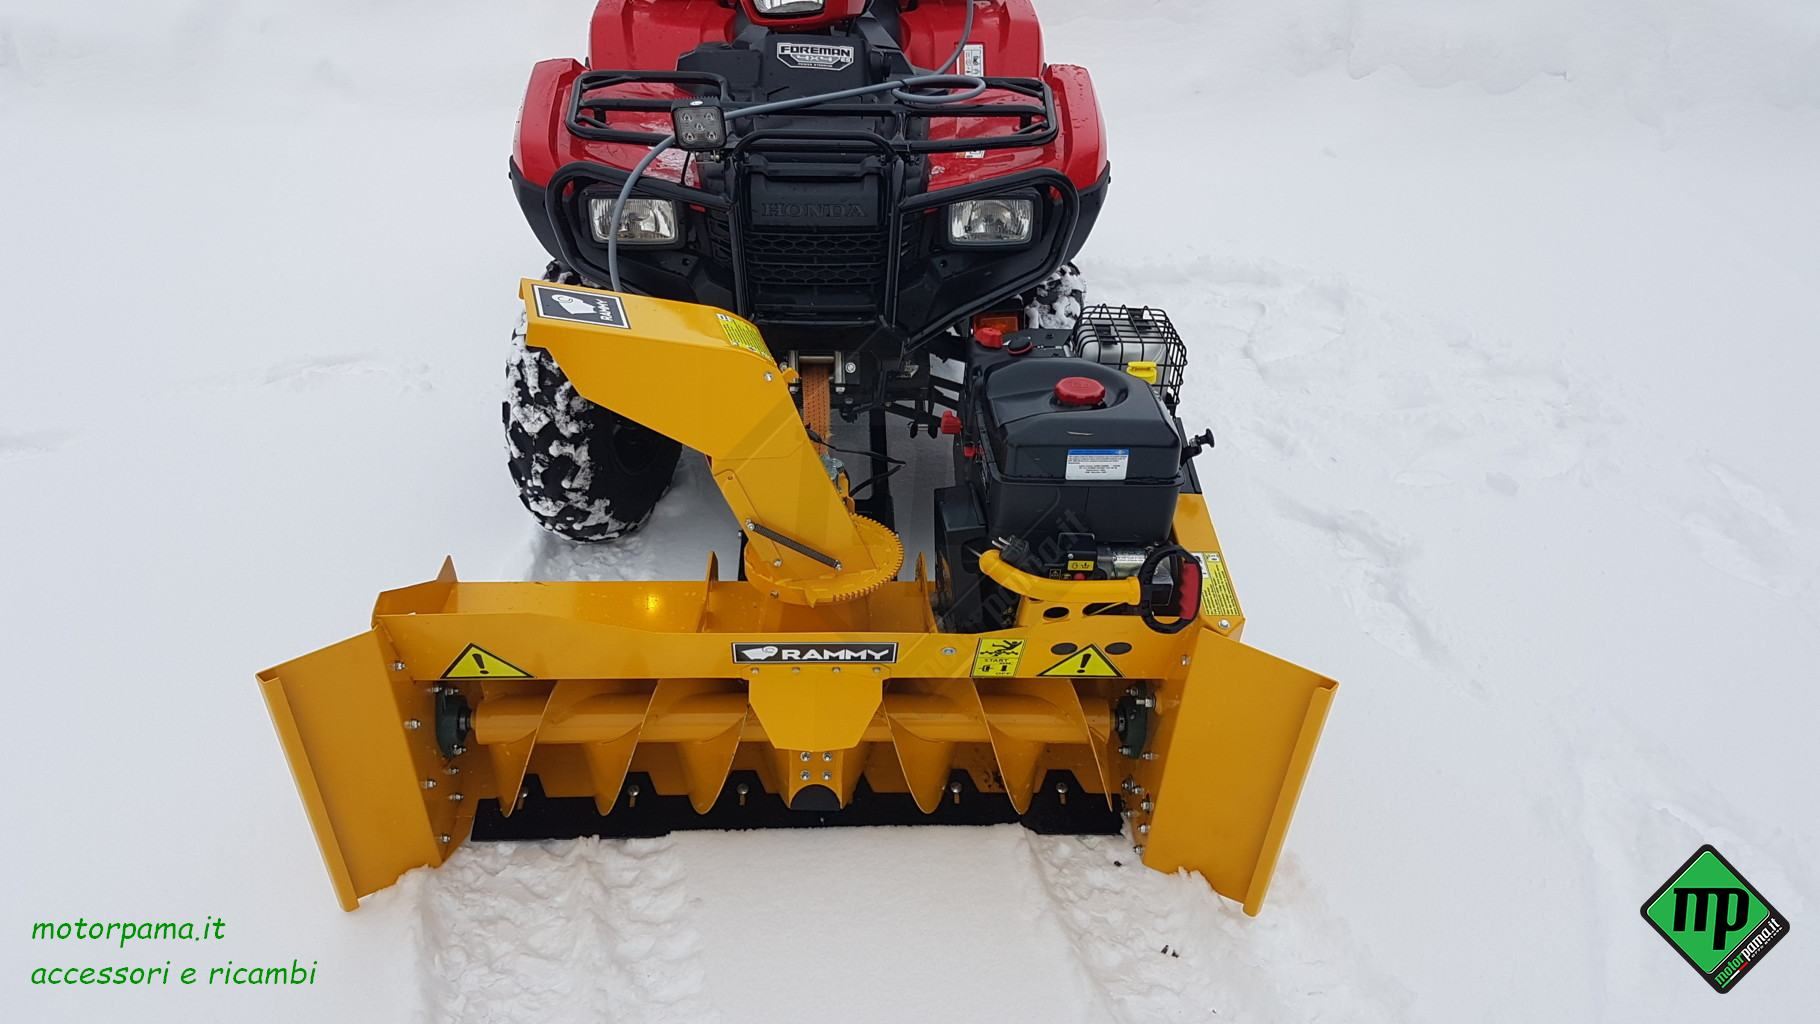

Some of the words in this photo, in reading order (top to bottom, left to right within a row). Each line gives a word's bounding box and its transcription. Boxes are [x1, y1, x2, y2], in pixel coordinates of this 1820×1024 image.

[780, 45, 851, 57] FOREMAN
[761, 202, 867, 217] HONDA
[596, 298, 614, 321] RAMMY
[781, 649, 889, 660] RAMMY
